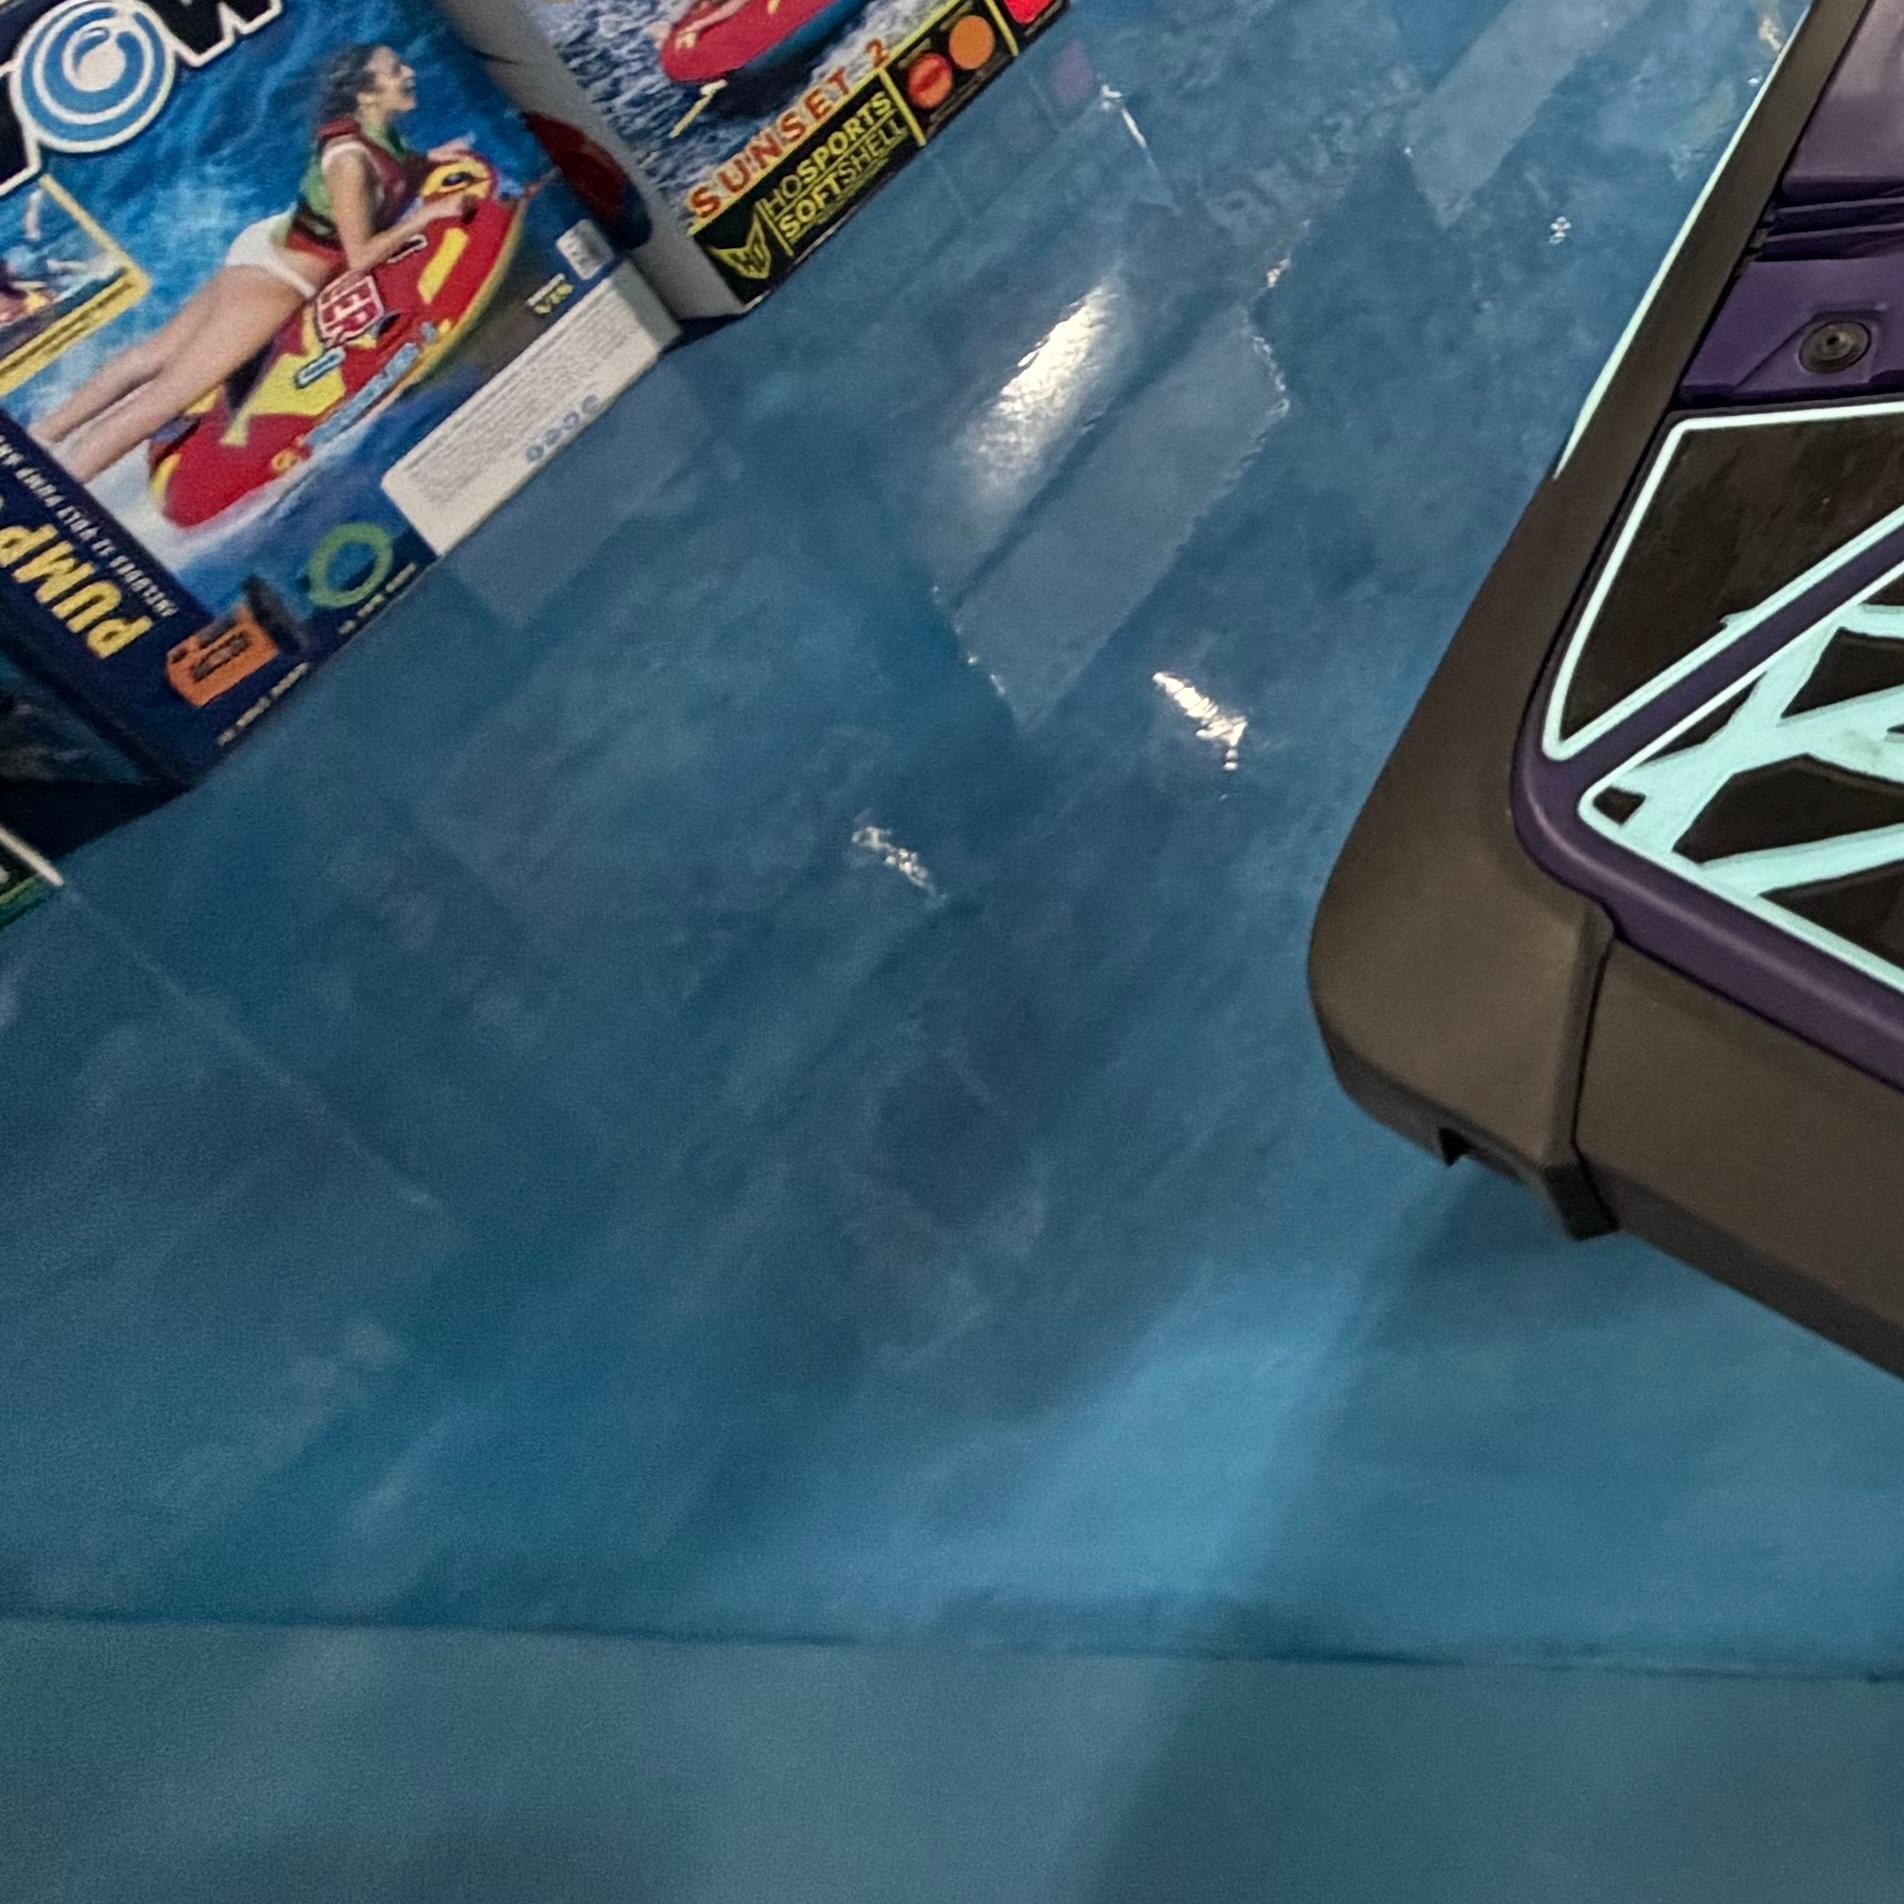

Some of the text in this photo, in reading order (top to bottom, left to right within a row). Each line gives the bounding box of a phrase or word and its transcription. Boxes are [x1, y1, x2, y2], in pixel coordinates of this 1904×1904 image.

[687, 39, 890, 220] SUNSET 2
[762, 88, 893, 217] HOSPORTS
[778, 116, 908, 240] SOFTSHELL
[0, 523, 154, 660] PUMP
